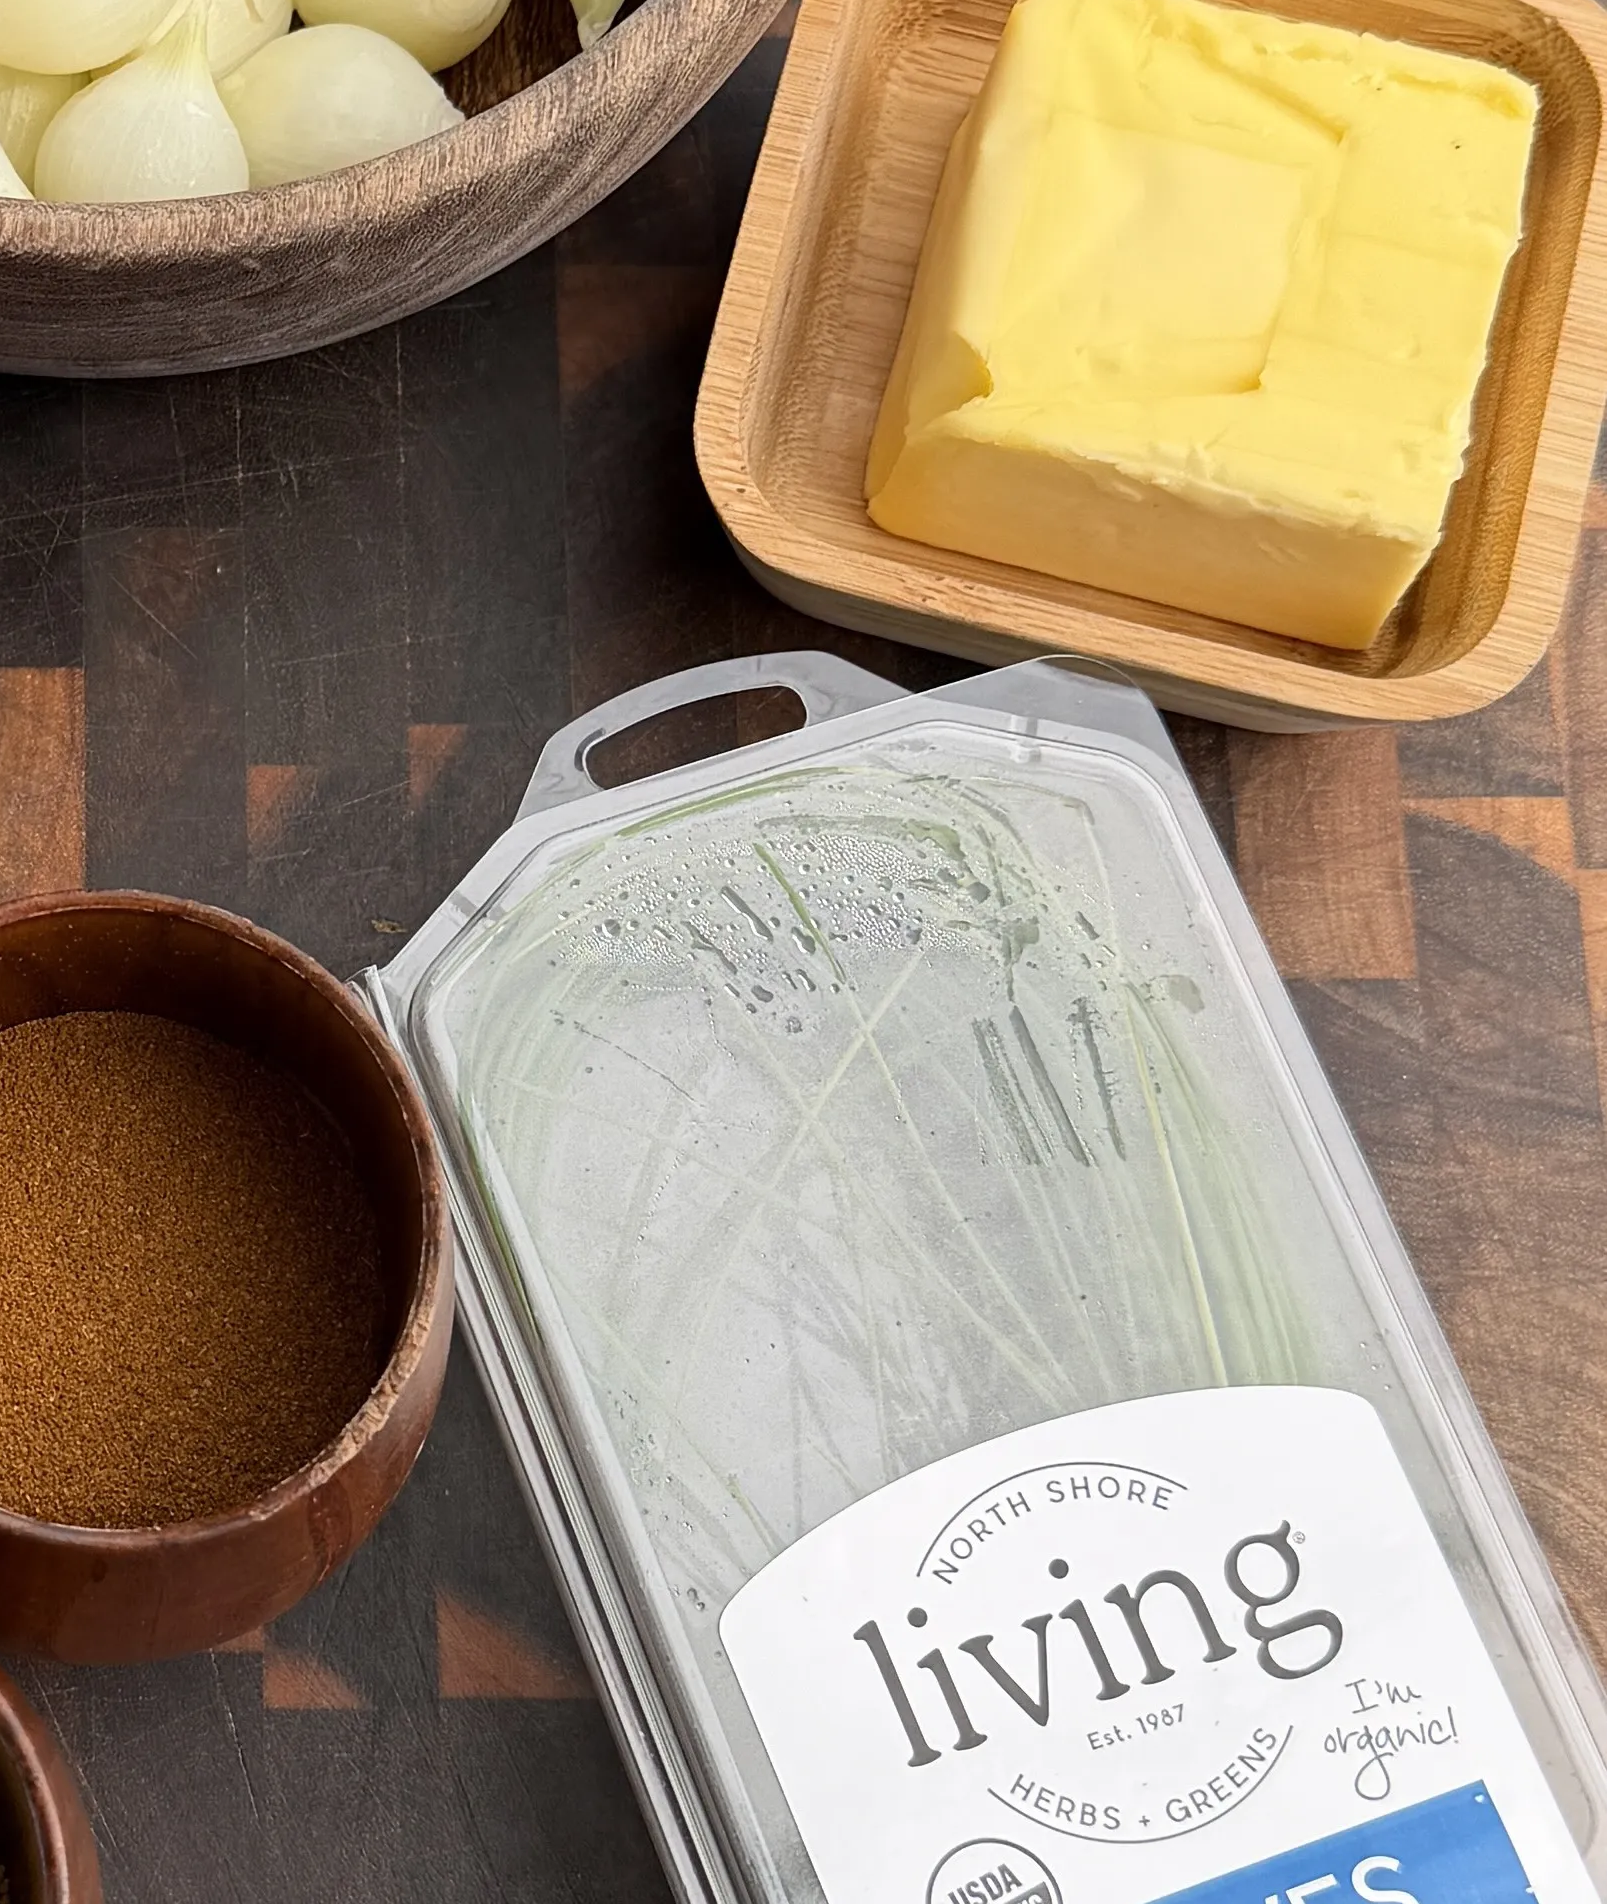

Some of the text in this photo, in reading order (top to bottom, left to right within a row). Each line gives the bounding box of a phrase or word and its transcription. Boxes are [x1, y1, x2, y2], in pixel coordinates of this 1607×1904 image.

[932, 1475, 1174, 1585] NORTH SHORE
[852, 1519, 1344, 1768] living
[1087, 1703, 1187, 1752] Est. 1987
[1345, 1678, 1422, 1714] I'm
[1009, 1773, 1122, 1831] HERBS
[1165, 1726, 1278, 1824] GREENS
[1324, 1706, 1460, 1801] organic!
